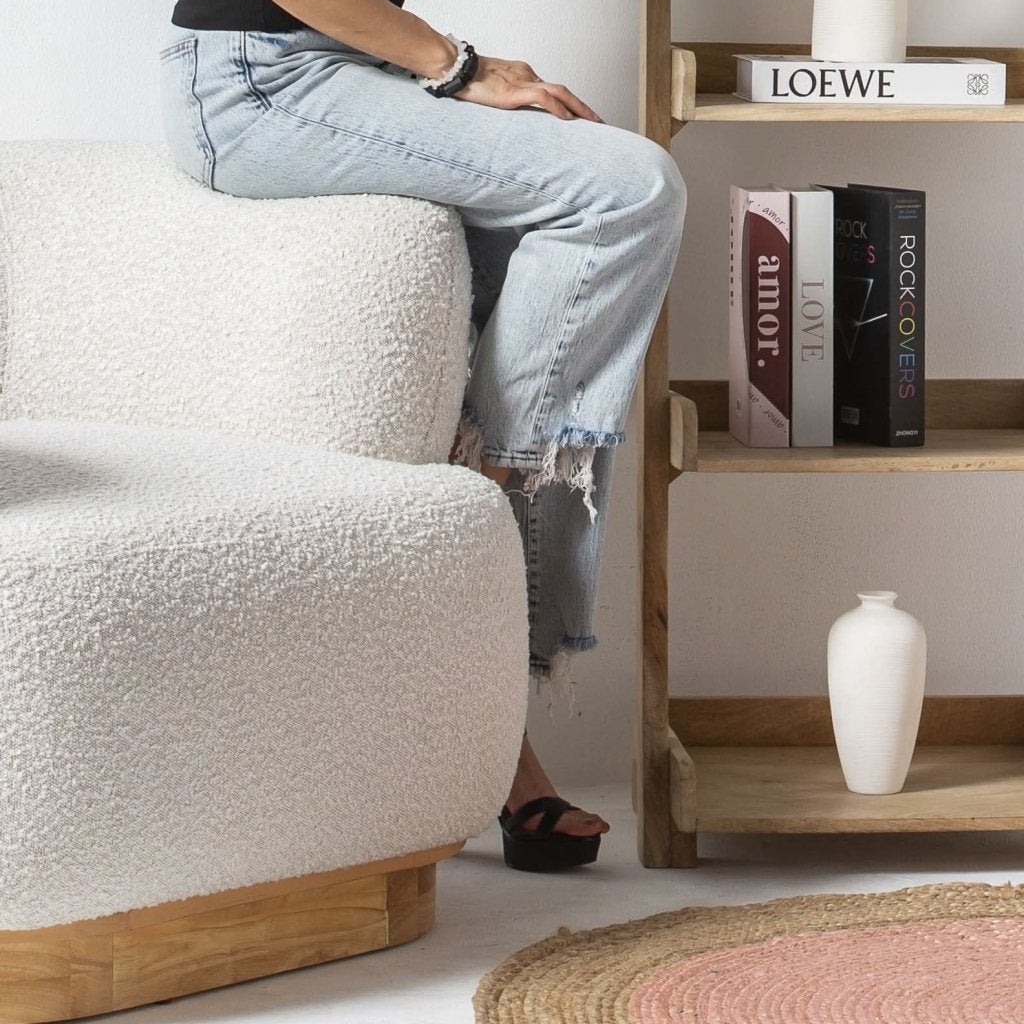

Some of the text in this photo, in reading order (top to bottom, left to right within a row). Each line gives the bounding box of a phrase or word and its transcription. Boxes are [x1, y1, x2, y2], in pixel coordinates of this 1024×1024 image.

[771, 68, 895, 98] LOEWE
[762, 207, 786, 225] amor
[801, 279, 824, 362] LOVE
